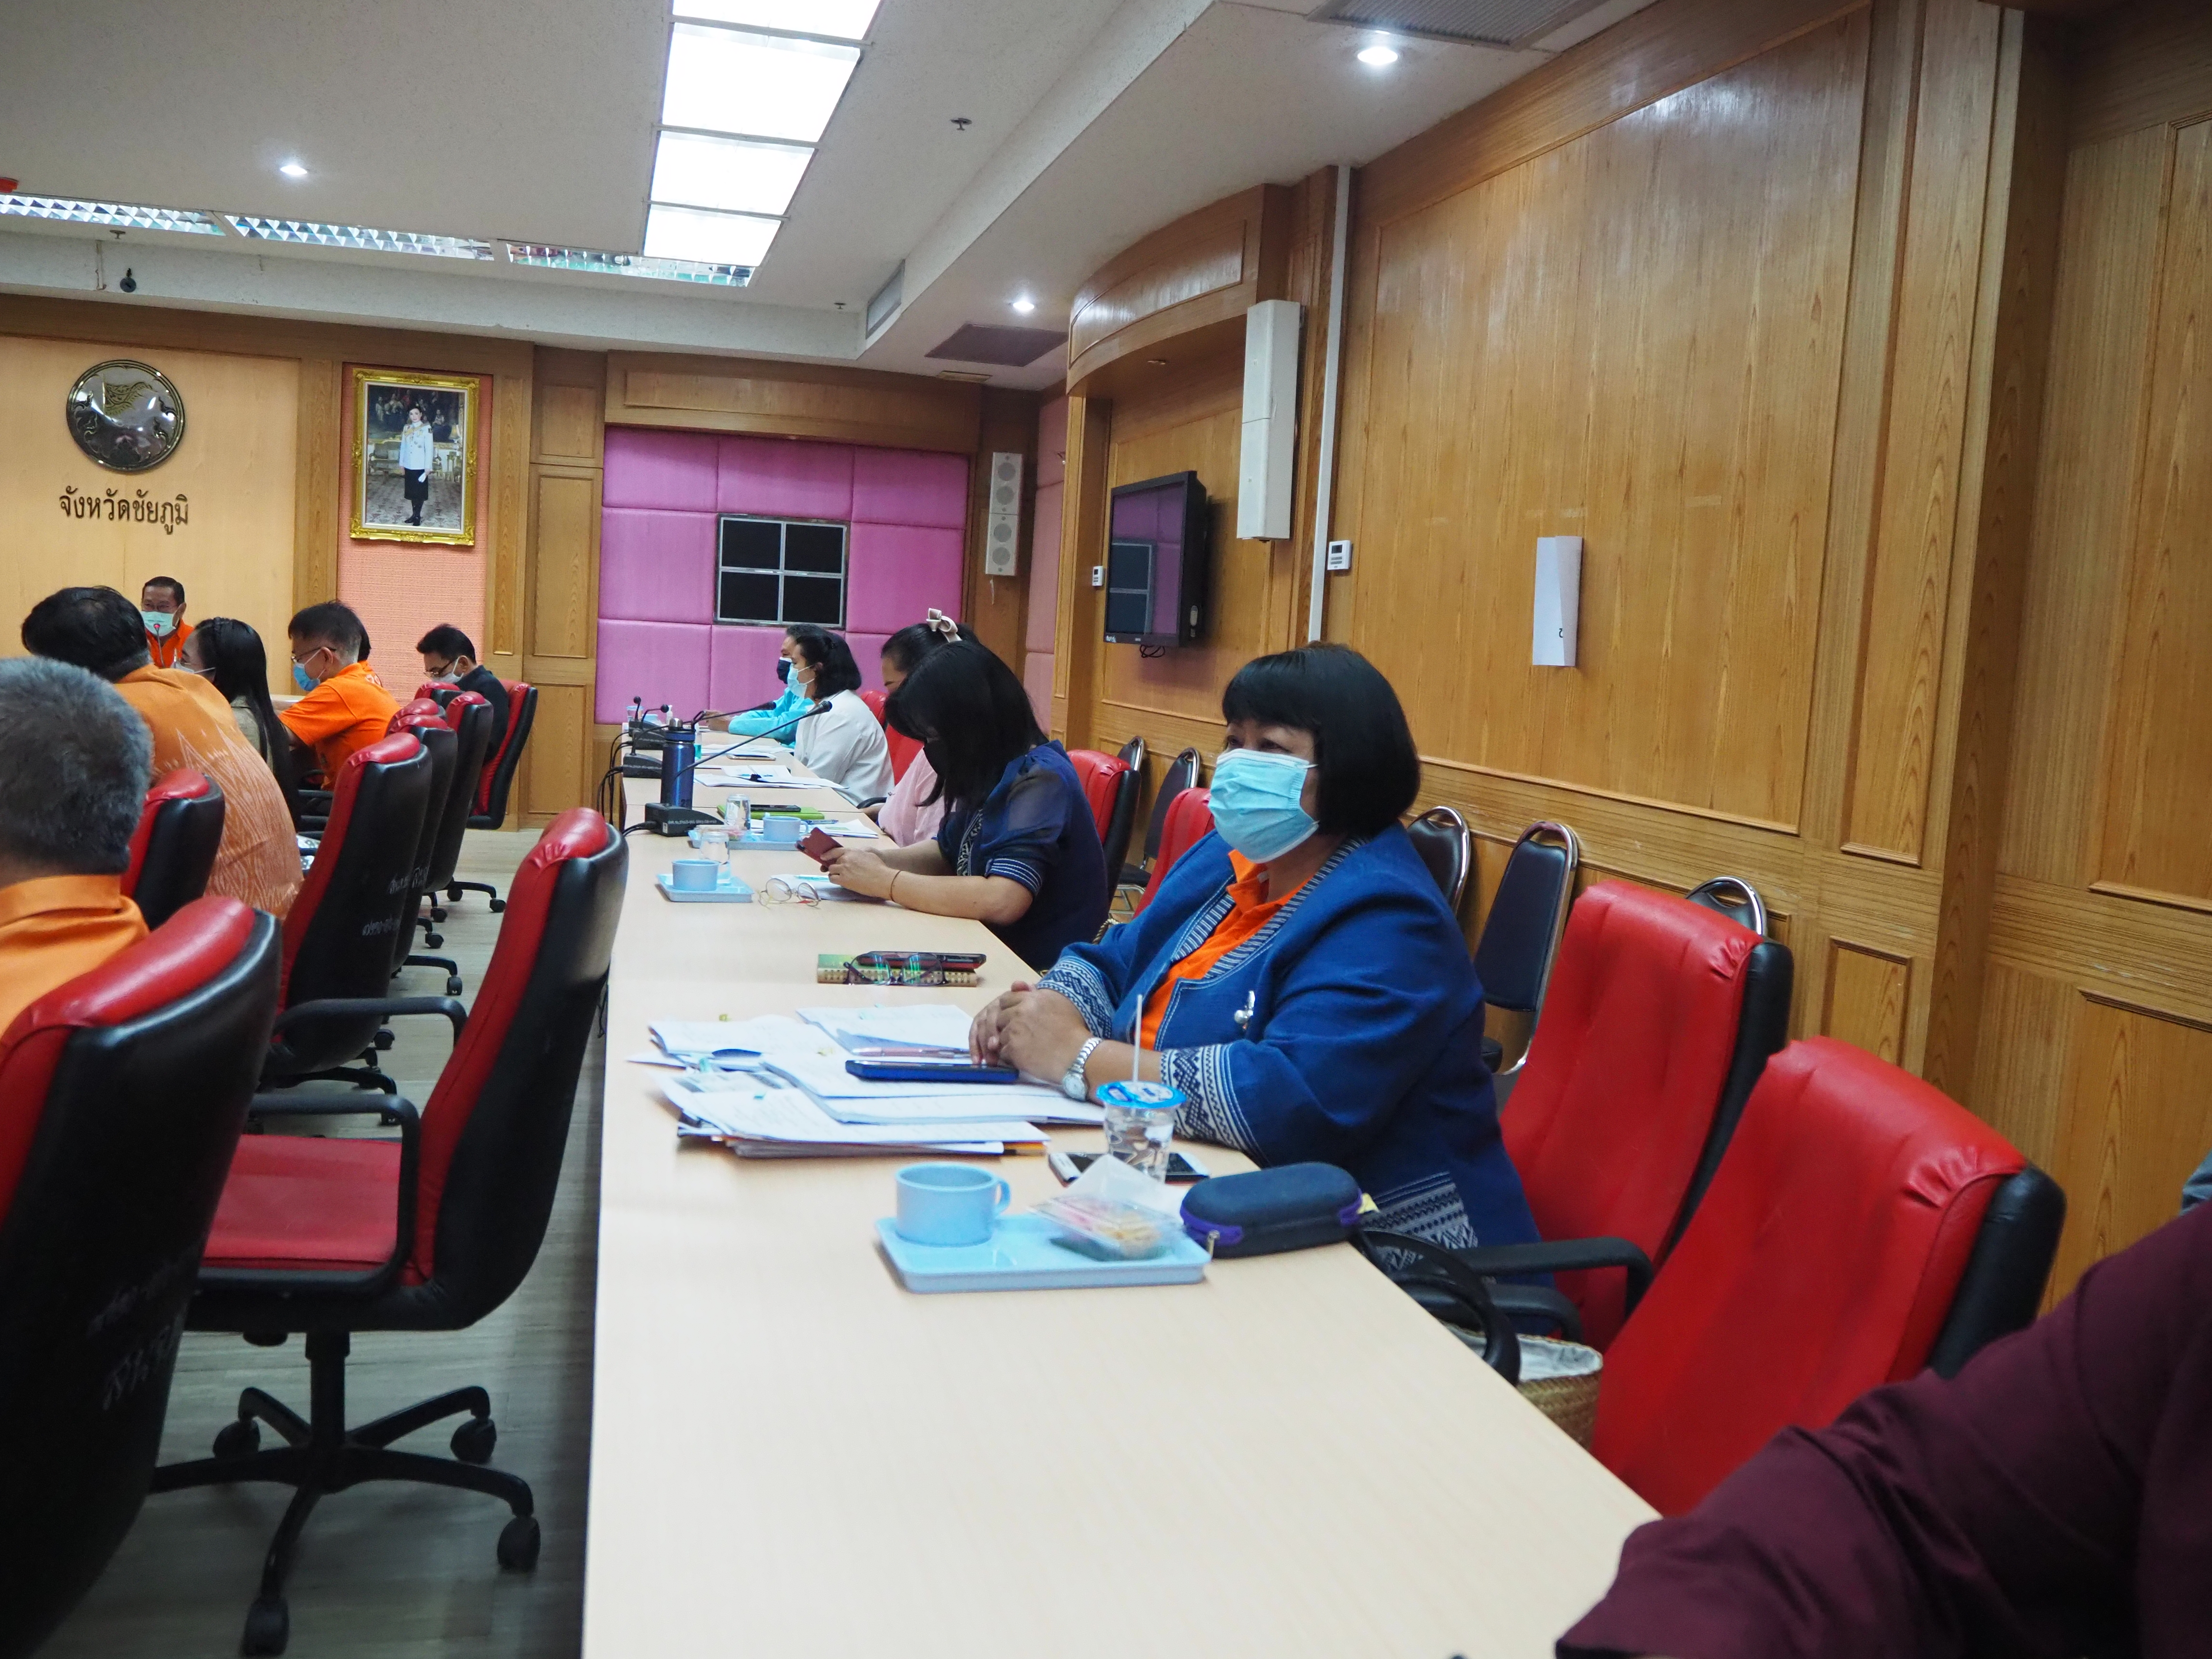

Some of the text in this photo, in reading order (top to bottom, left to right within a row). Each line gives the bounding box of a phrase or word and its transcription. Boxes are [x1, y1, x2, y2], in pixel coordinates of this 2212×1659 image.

[59, 485, 188, 535] จังหวัดชัยภูมิ
